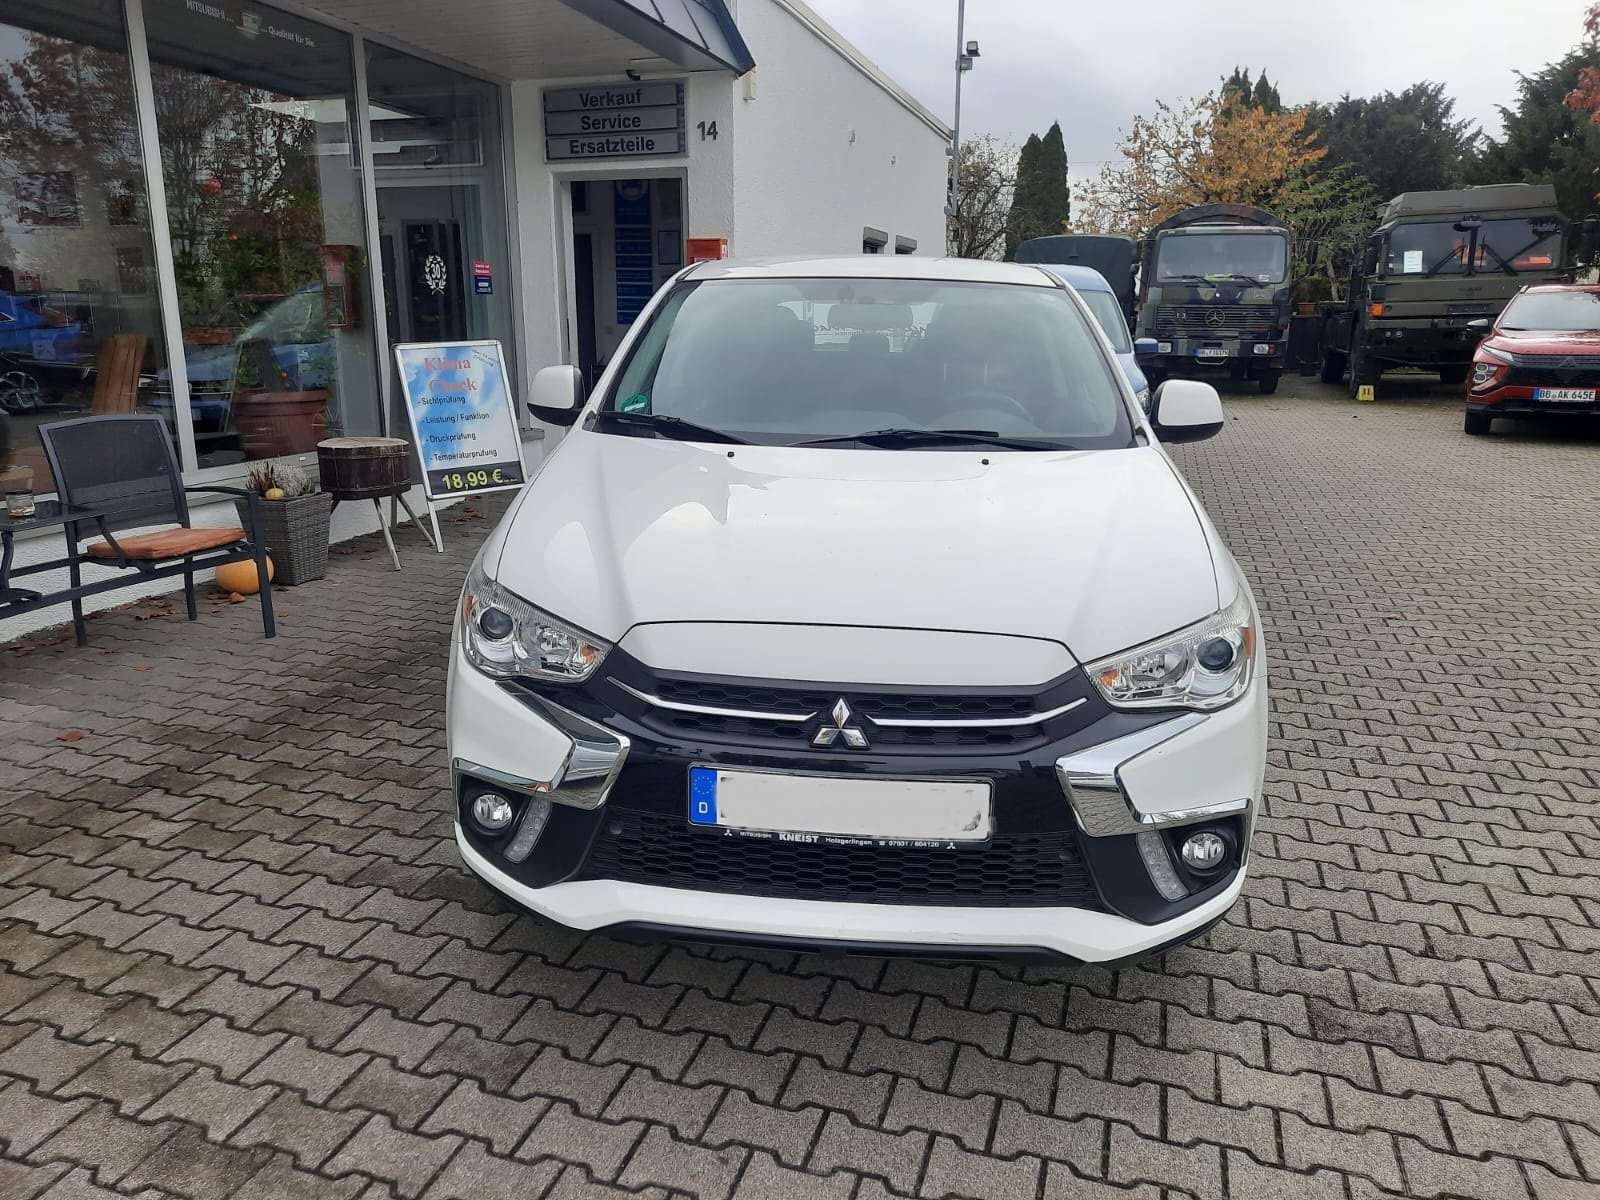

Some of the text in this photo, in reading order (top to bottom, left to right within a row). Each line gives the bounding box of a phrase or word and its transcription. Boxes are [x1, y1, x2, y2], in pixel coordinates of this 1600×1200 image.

[579, 88, 642, 107] Verkauf
[581, 113, 641, 131] Service
[696, 120, 718, 139] 14
[569, 137, 655, 154] Ersatzteile
[430, 263, 441, 278] 30
[424, 356, 471, 371] Klima
[1558, 390, 1569, 399] AK
[1571, 390, 1595, 399] 645E
[442, 470, 488, 490] 18,99
[698, 802, 708, 813] D
[779, 832, 819, 843] KNEIST
